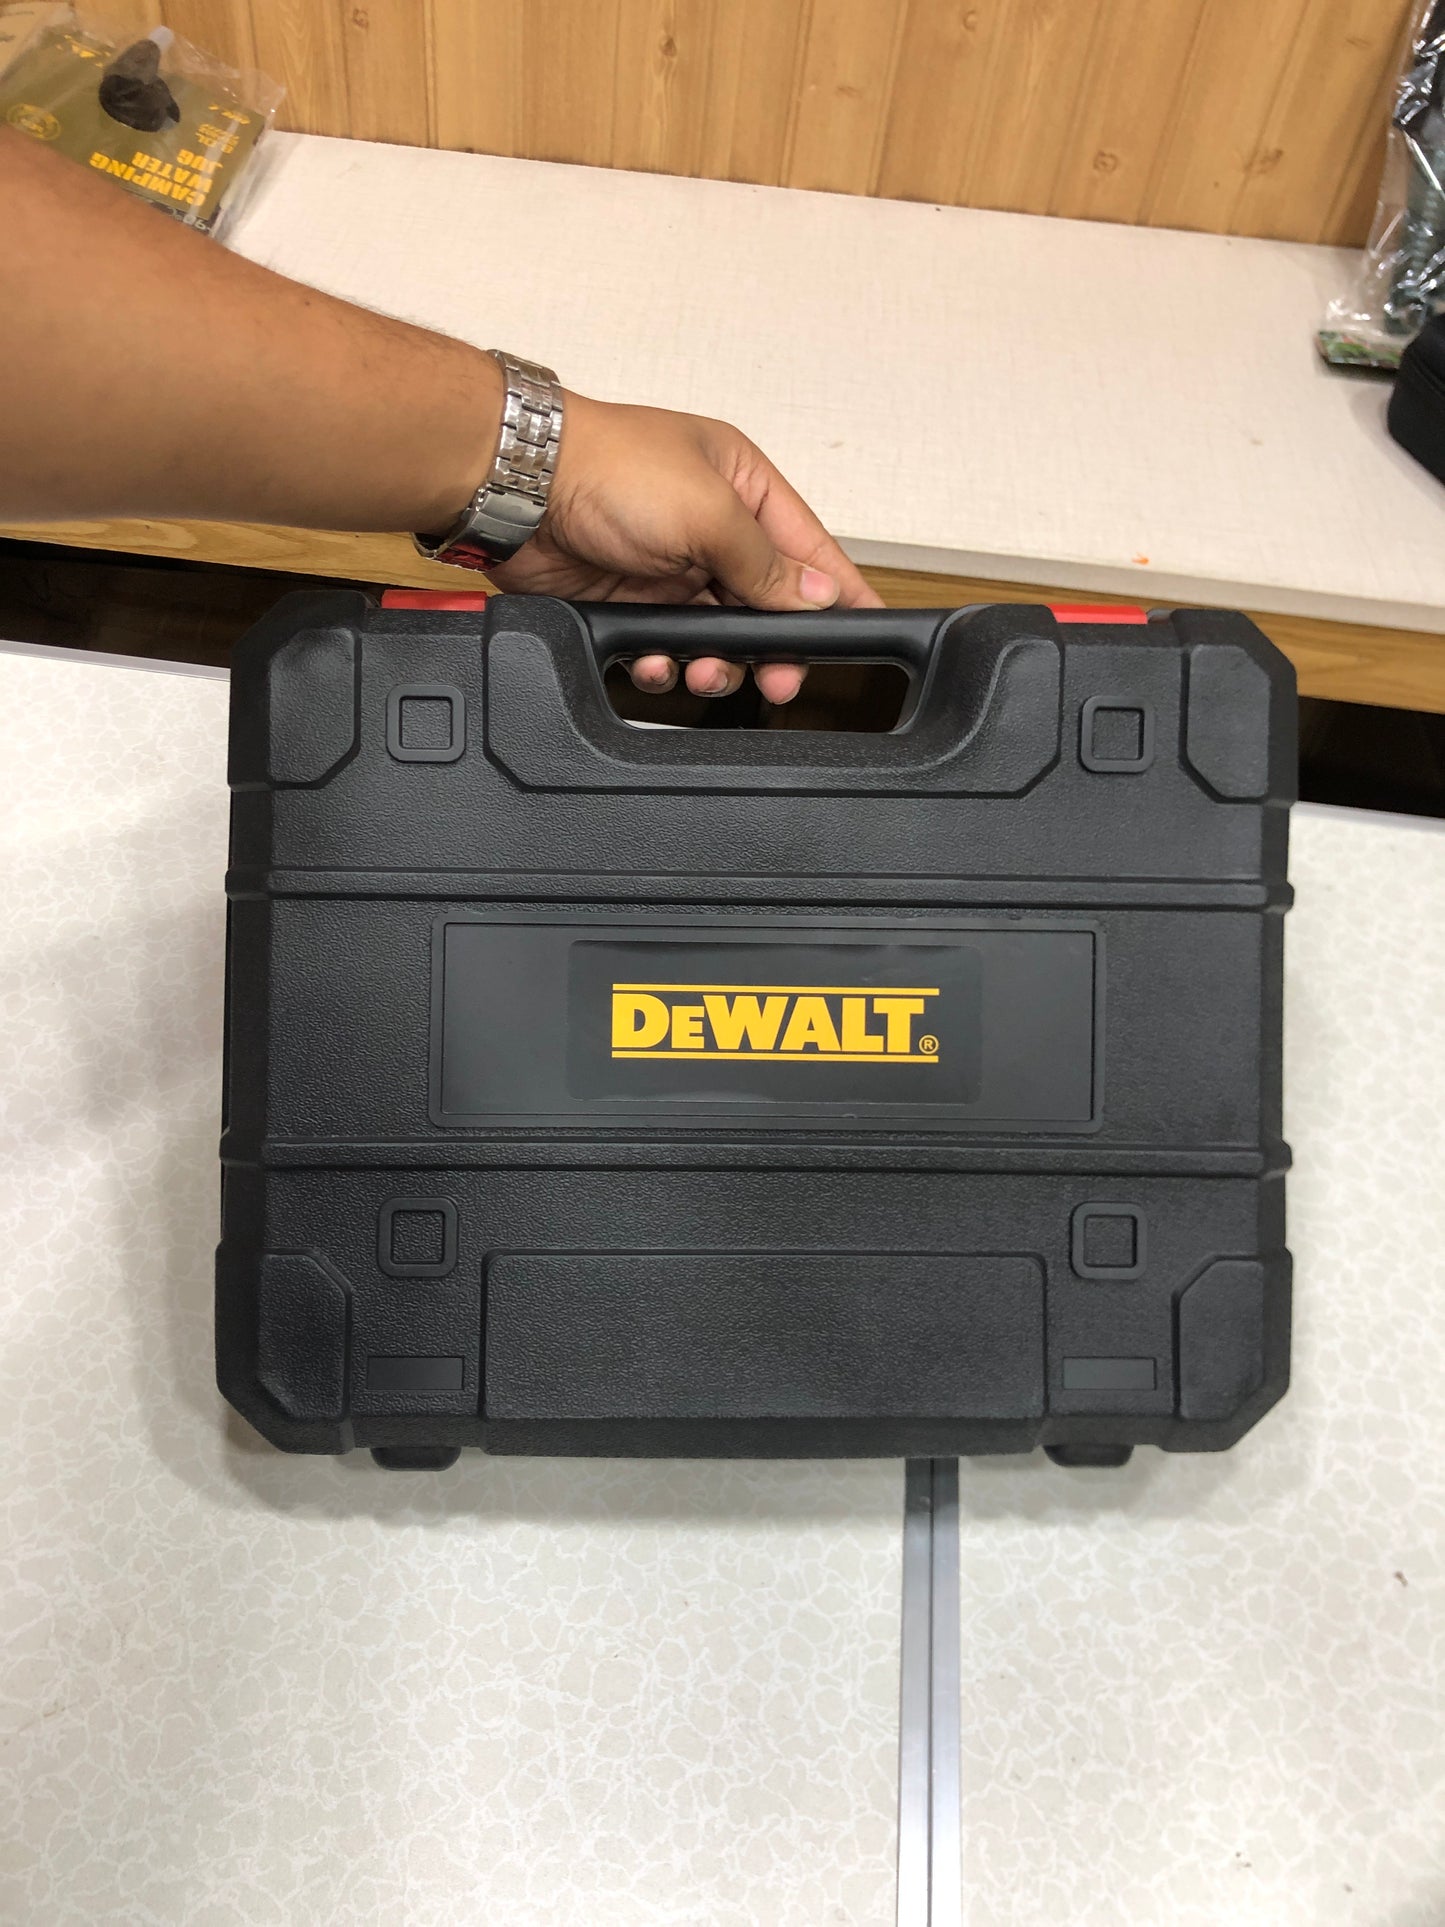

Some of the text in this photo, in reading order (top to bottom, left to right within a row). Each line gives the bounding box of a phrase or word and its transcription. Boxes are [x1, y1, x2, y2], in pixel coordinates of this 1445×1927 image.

[90, 152, 206, 206] CAMPING
[131, 152, 213, 193] WATER
[177, 149, 223, 173] JUG
